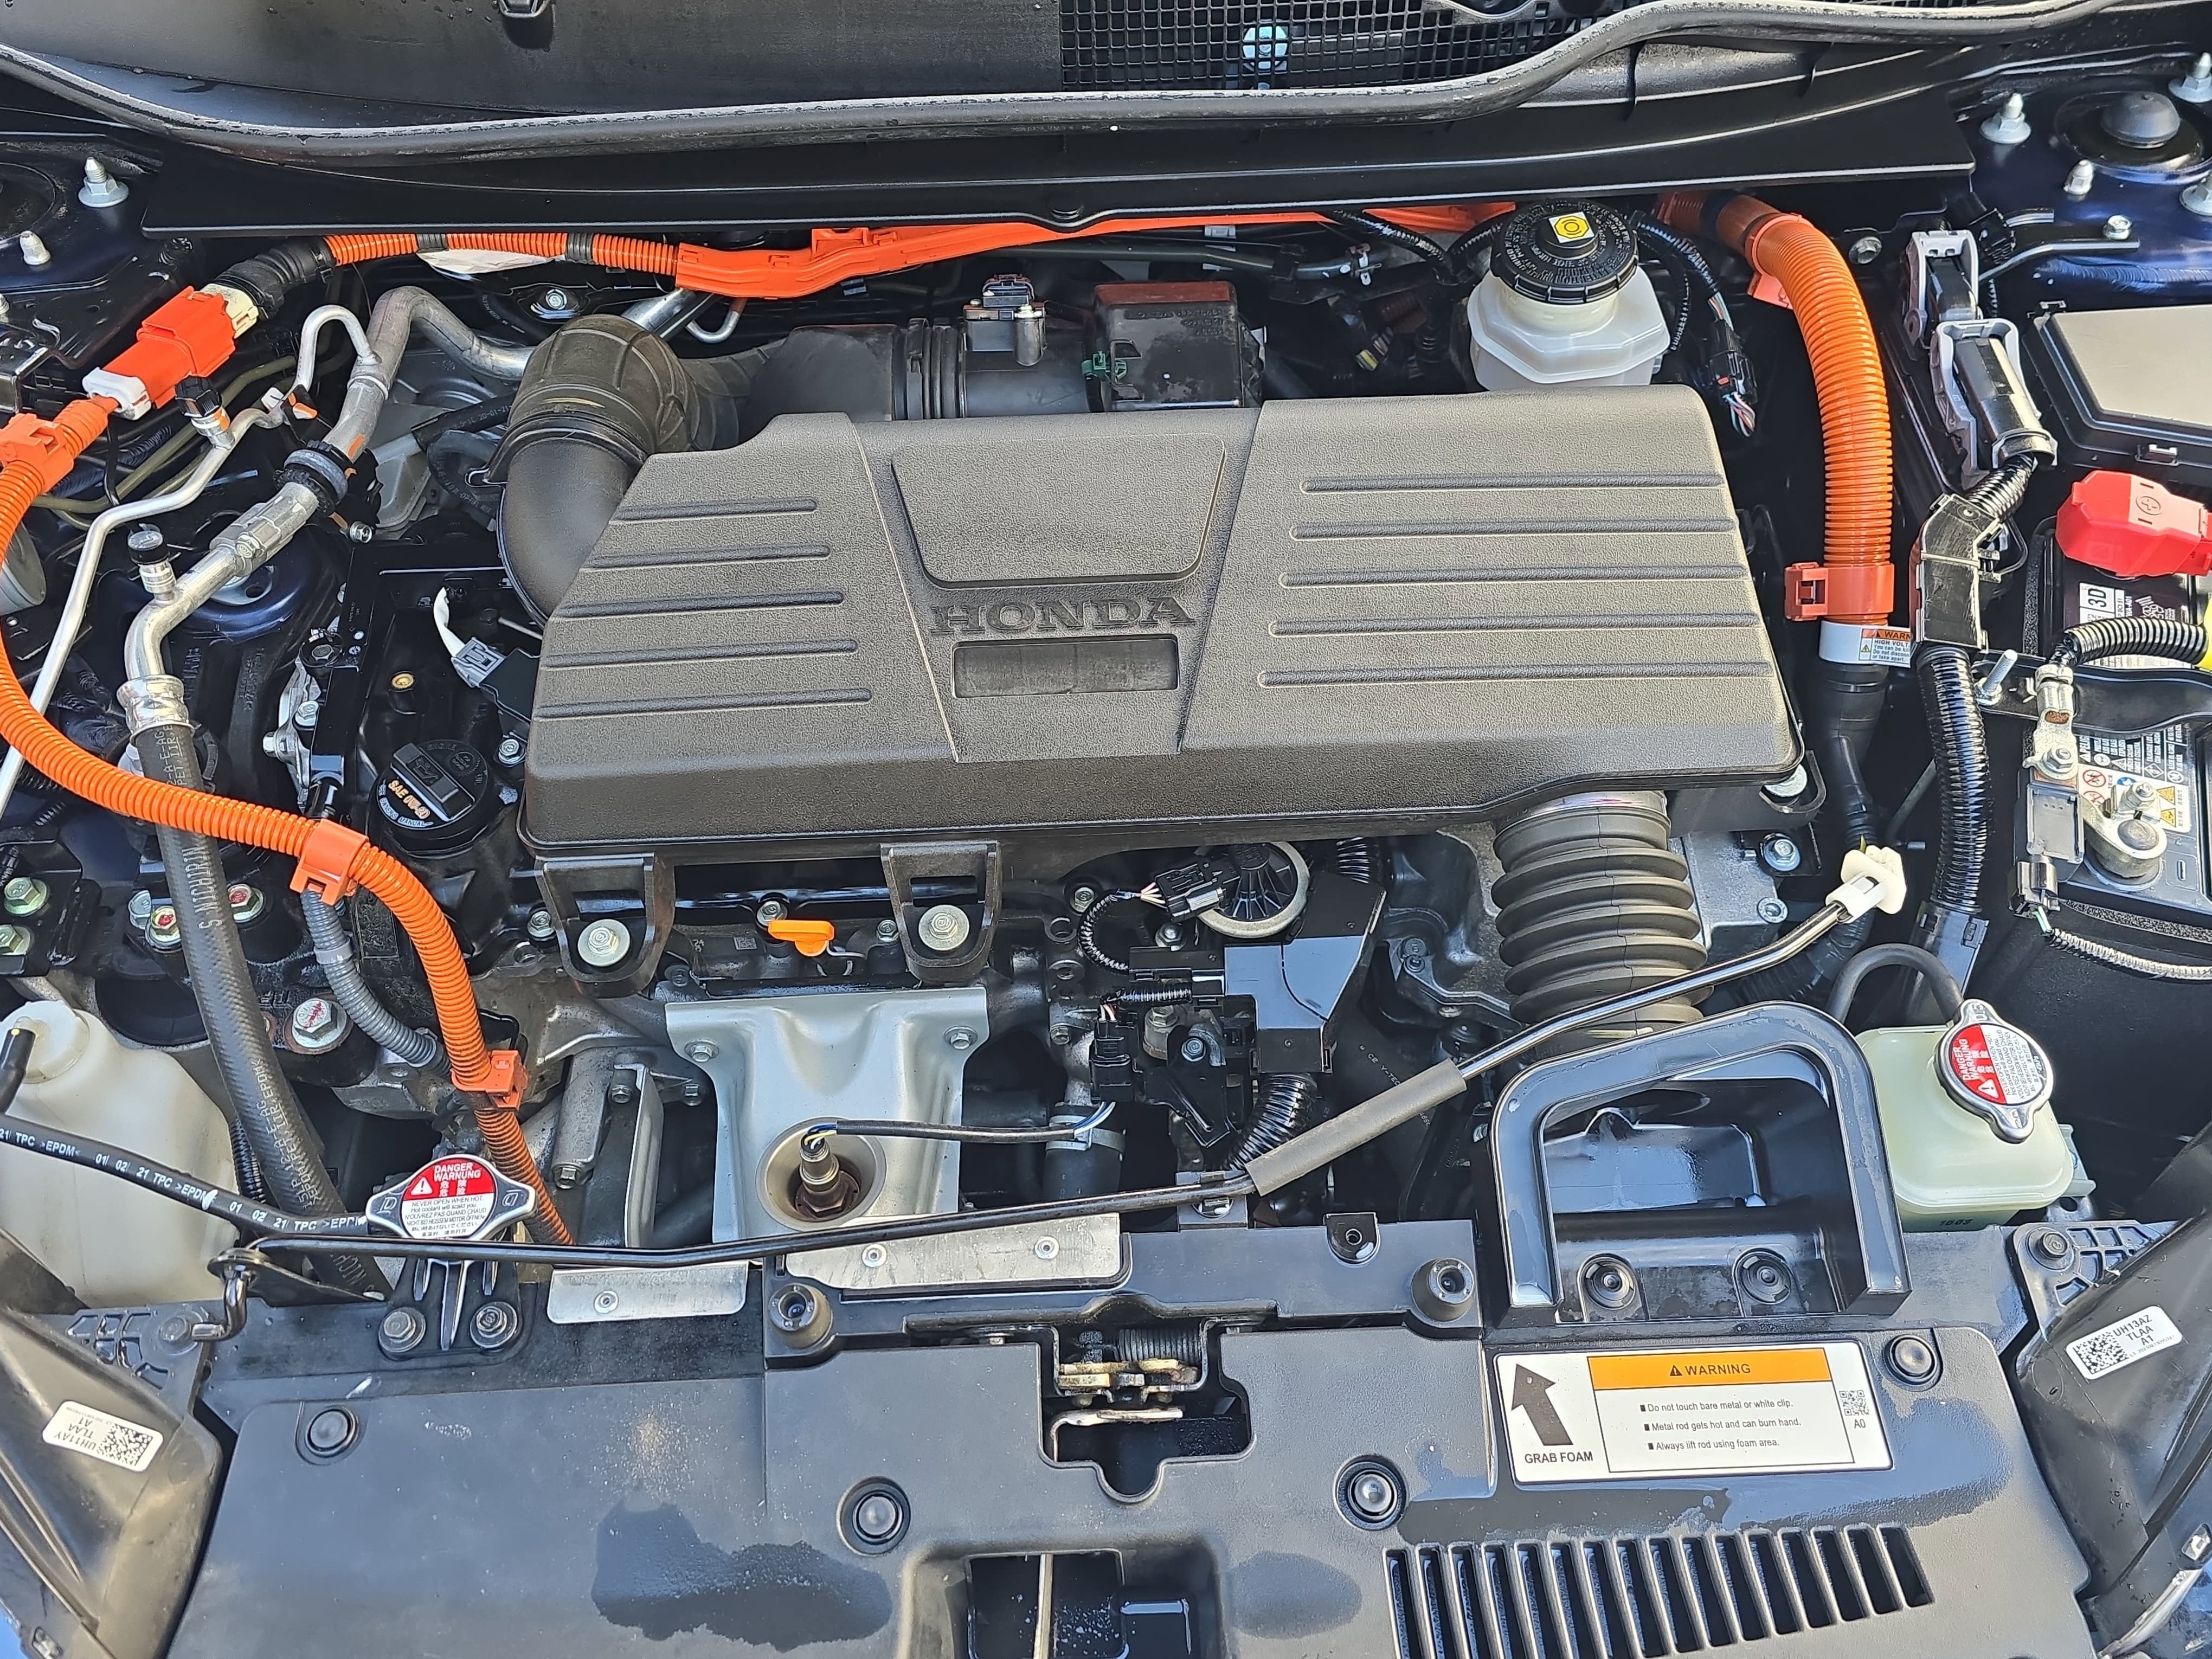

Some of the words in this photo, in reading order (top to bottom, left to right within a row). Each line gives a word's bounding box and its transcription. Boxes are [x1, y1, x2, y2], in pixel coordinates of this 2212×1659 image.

[2088, 588, 2107, 608] 3D
[930, 596, 1195, 633] HONDA
[1885, 631, 1911, 640] WARN
[2080, 736, 2090, 753] PELIG
[388, 780, 409, 799] SAE
[397, 816, 426, 828] MANUAL
[1952, 1046, 1970, 1081] DANGER
[1959, 1038, 1978, 1081] WARNUNG
[434, 1162, 473, 1173] DANGER
[15, 1131, 35, 1147] TPC
[153, 1172, 173, 1189] TPC
[294, 1220, 317, 1231] TPC
[434, 1169, 481, 1181] WARNUNG
[2113, 1314, 2152, 1337] UH13AZ
[2125, 1326, 2154, 1341] TLAA
[2141, 1335, 2154, 1346] A1
[1684, 1363, 1751, 1375] WARNING
[1676, 1400, 1698, 1411] touch
[1700, 1399, 1718, 1410] bare
[1720, 1399, 1742, 1410] metal
[1754, 1397, 1775, 1408] white
[1777, 1397, 1793, 1410] clip.
[79, 1417, 93, 1427] A1
[1651, 1423, 1674, 1431] Metal
[1676, 1421, 1689, 1431] rod
[1691, 1420, 1708, 1431] gets
[1710, 1419, 1724, 1429] hot
[1725, 1419, 1740, 1429] and
[1758, 1418, 1778, 1427] burn
[1779, 1417, 1802, 1426] hand.
[1854, 1418, 1866, 1429] A0
[68, 1423, 94, 1439] TLAA
[54, 1431, 97, 1450] UH11AY
[1656, 1441, 1684, 1451] Always
[1686, 1439, 1696, 1449] lift
[1698, 1439, 1712, 1449] rod
[1713, 1439, 1735, 1450] using
[1737, 1438, 1758, 1448] foam
[1759, 1438, 1780, 1447] area.
[1525, 1452, 1557, 1464] GRAB
[1560, 1451, 1593, 1463] FOAM
